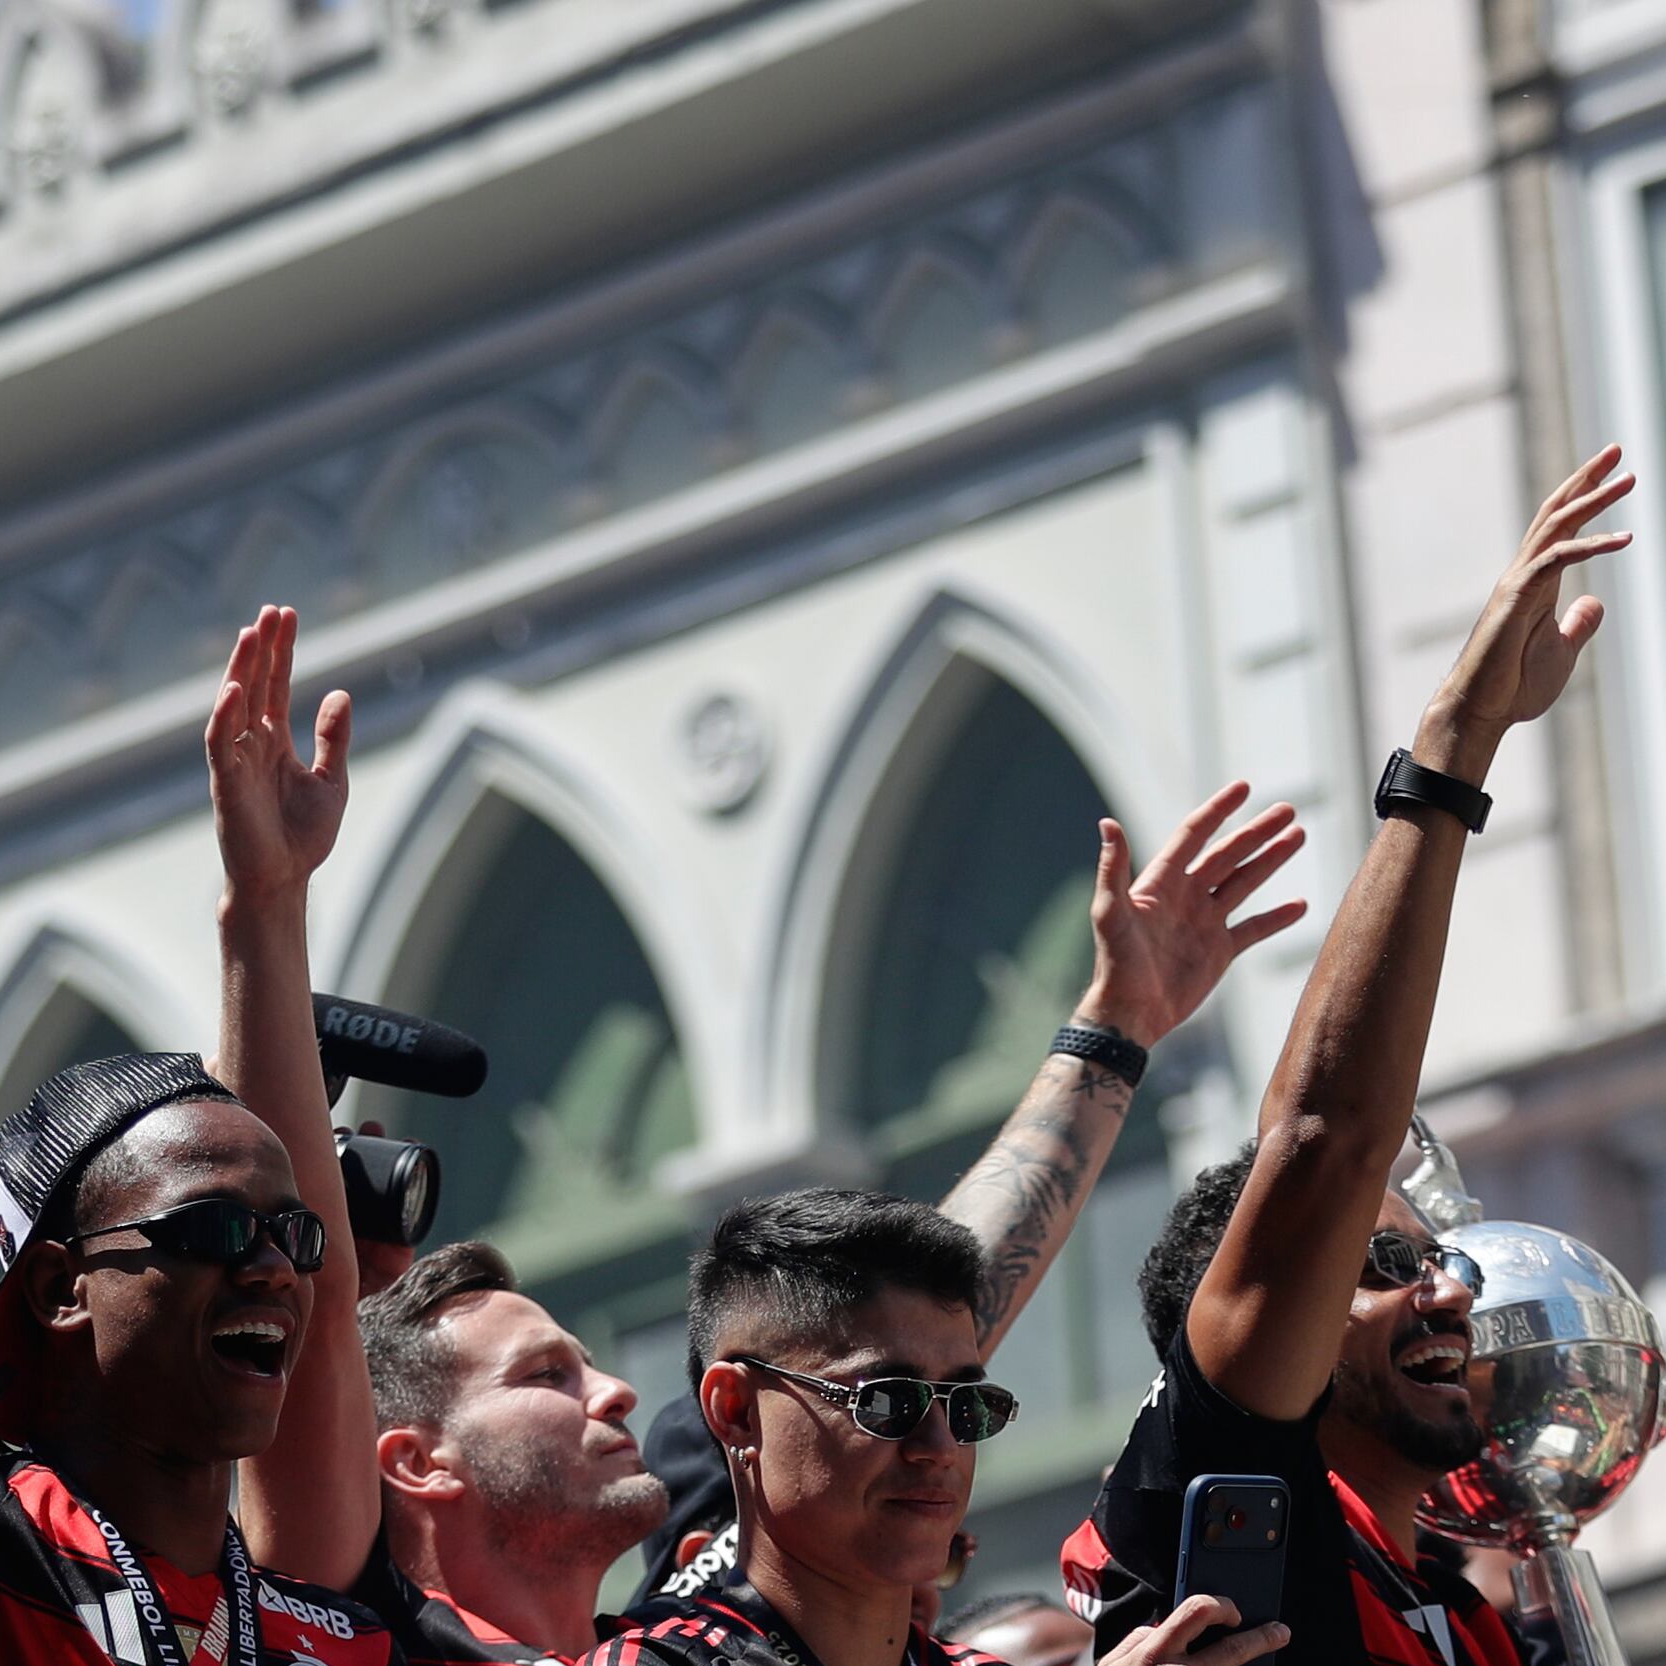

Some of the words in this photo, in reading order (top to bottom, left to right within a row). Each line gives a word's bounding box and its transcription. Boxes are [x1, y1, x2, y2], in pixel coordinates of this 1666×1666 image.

[324, 1006, 422, 1054] RØDE
[92, 1509, 167, 1637] CONMEBOL
[661, 1523, 739, 1598] Shop
[284, 1595, 355, 1640] BRB
